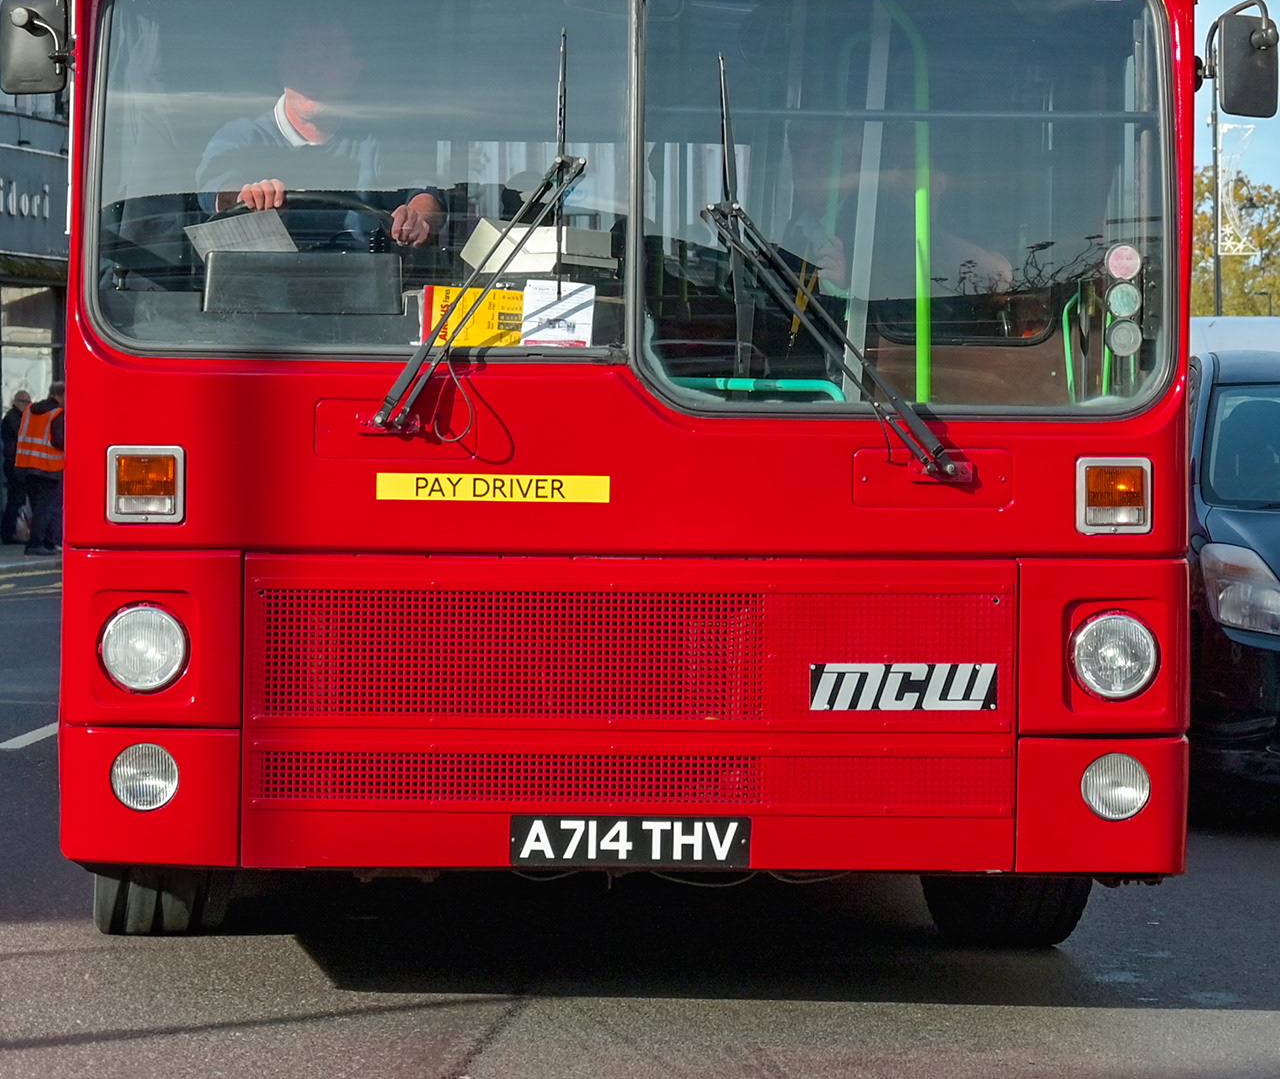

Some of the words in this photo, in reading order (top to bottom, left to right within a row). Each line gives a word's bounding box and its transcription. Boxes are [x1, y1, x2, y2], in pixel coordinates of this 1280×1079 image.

[415, 476, 463, 497] PAY
[472, 477, 566, 499] DRIVER
[520, 819, 633, 860] A714
[641, 821, 738, 861] THV
